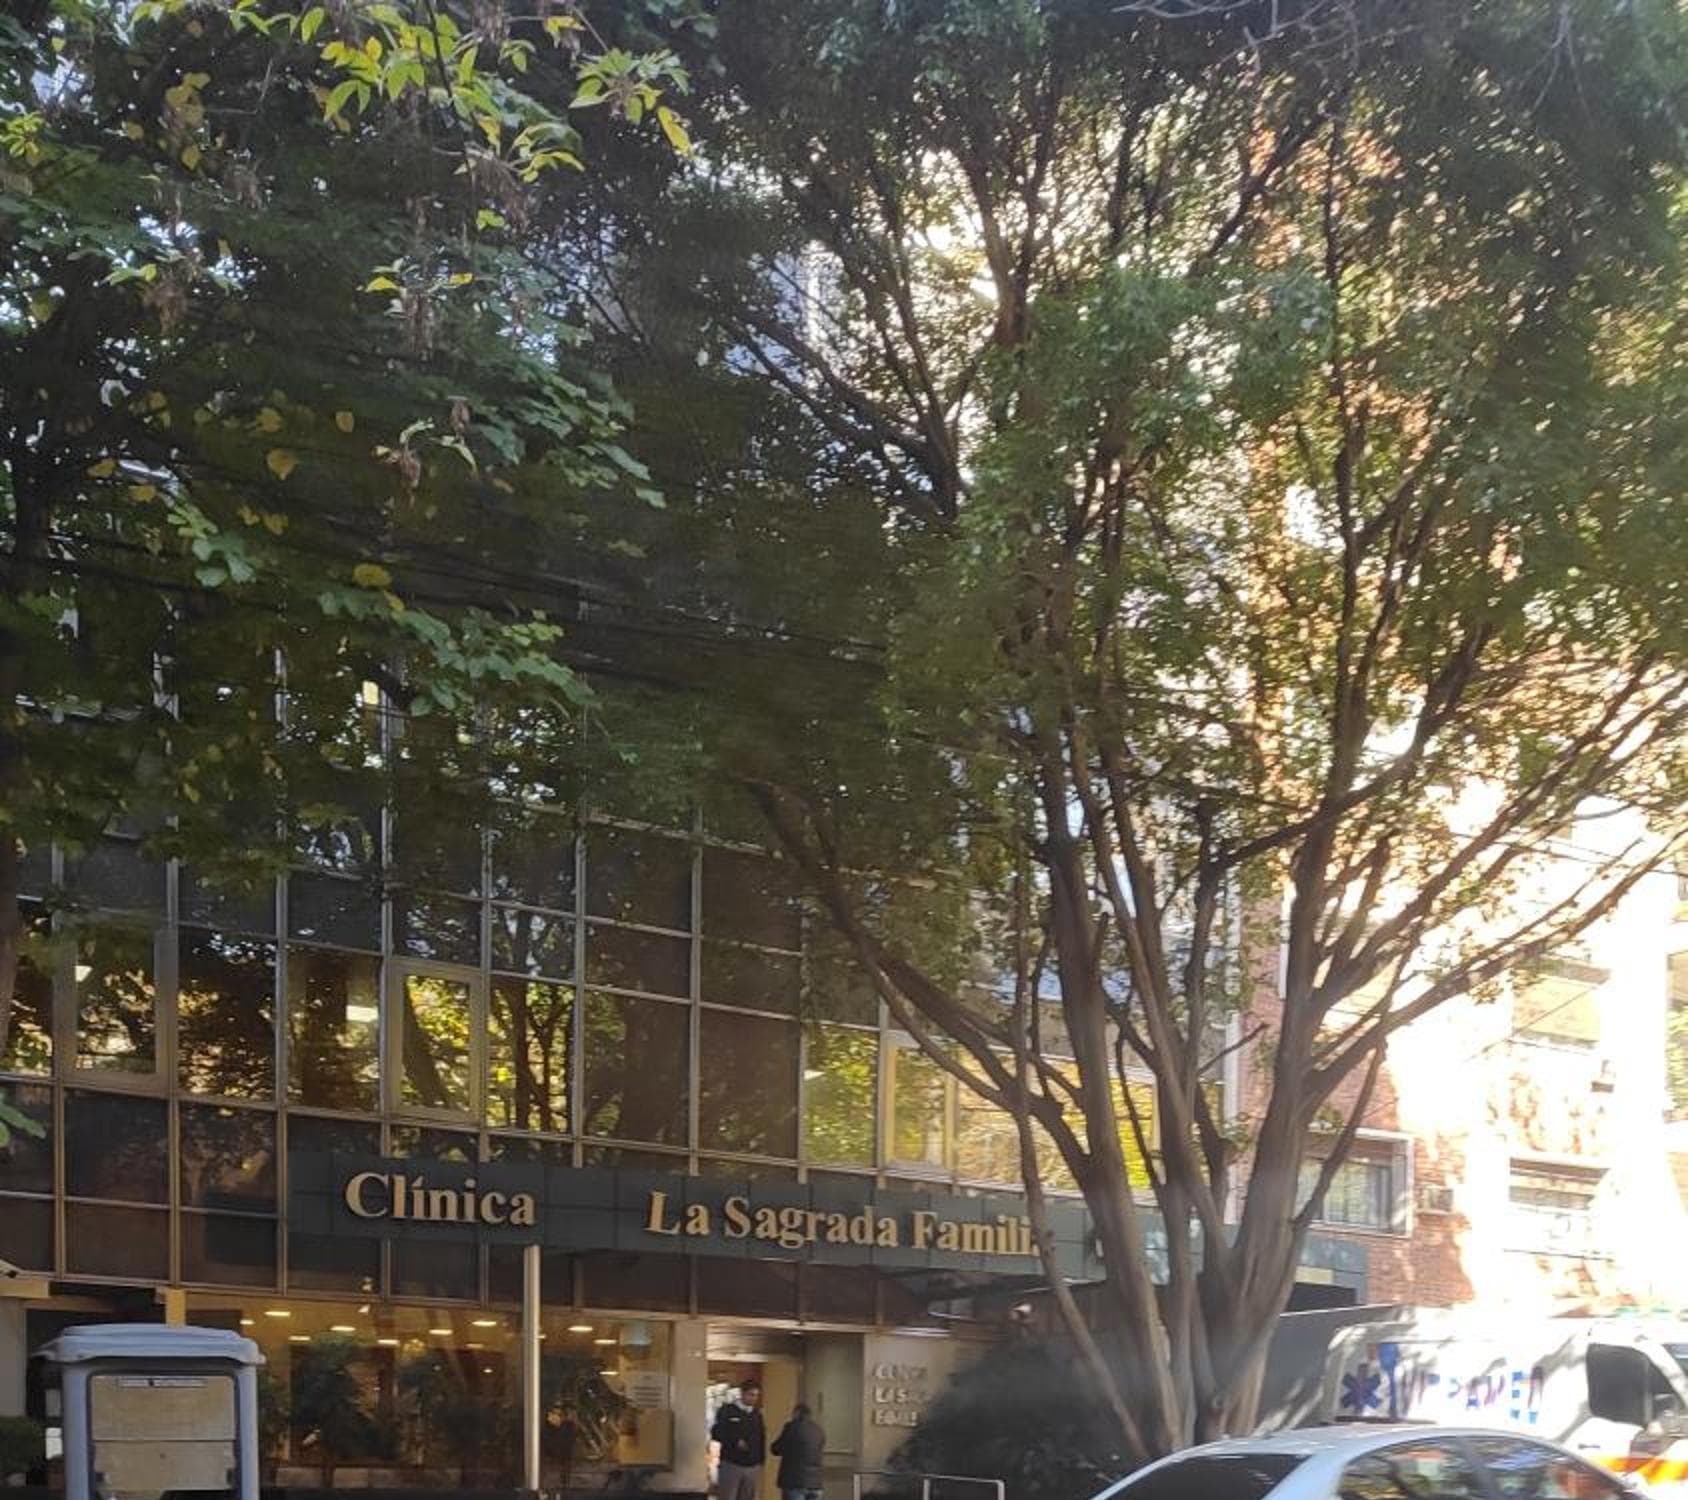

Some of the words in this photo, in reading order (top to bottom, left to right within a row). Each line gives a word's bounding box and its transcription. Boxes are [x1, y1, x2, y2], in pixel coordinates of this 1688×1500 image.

[345, 1171, 537, 1225] Clínica
[645, 1191, 711, 1236] La
[724, 1196, 900, 1249] Sagrada
